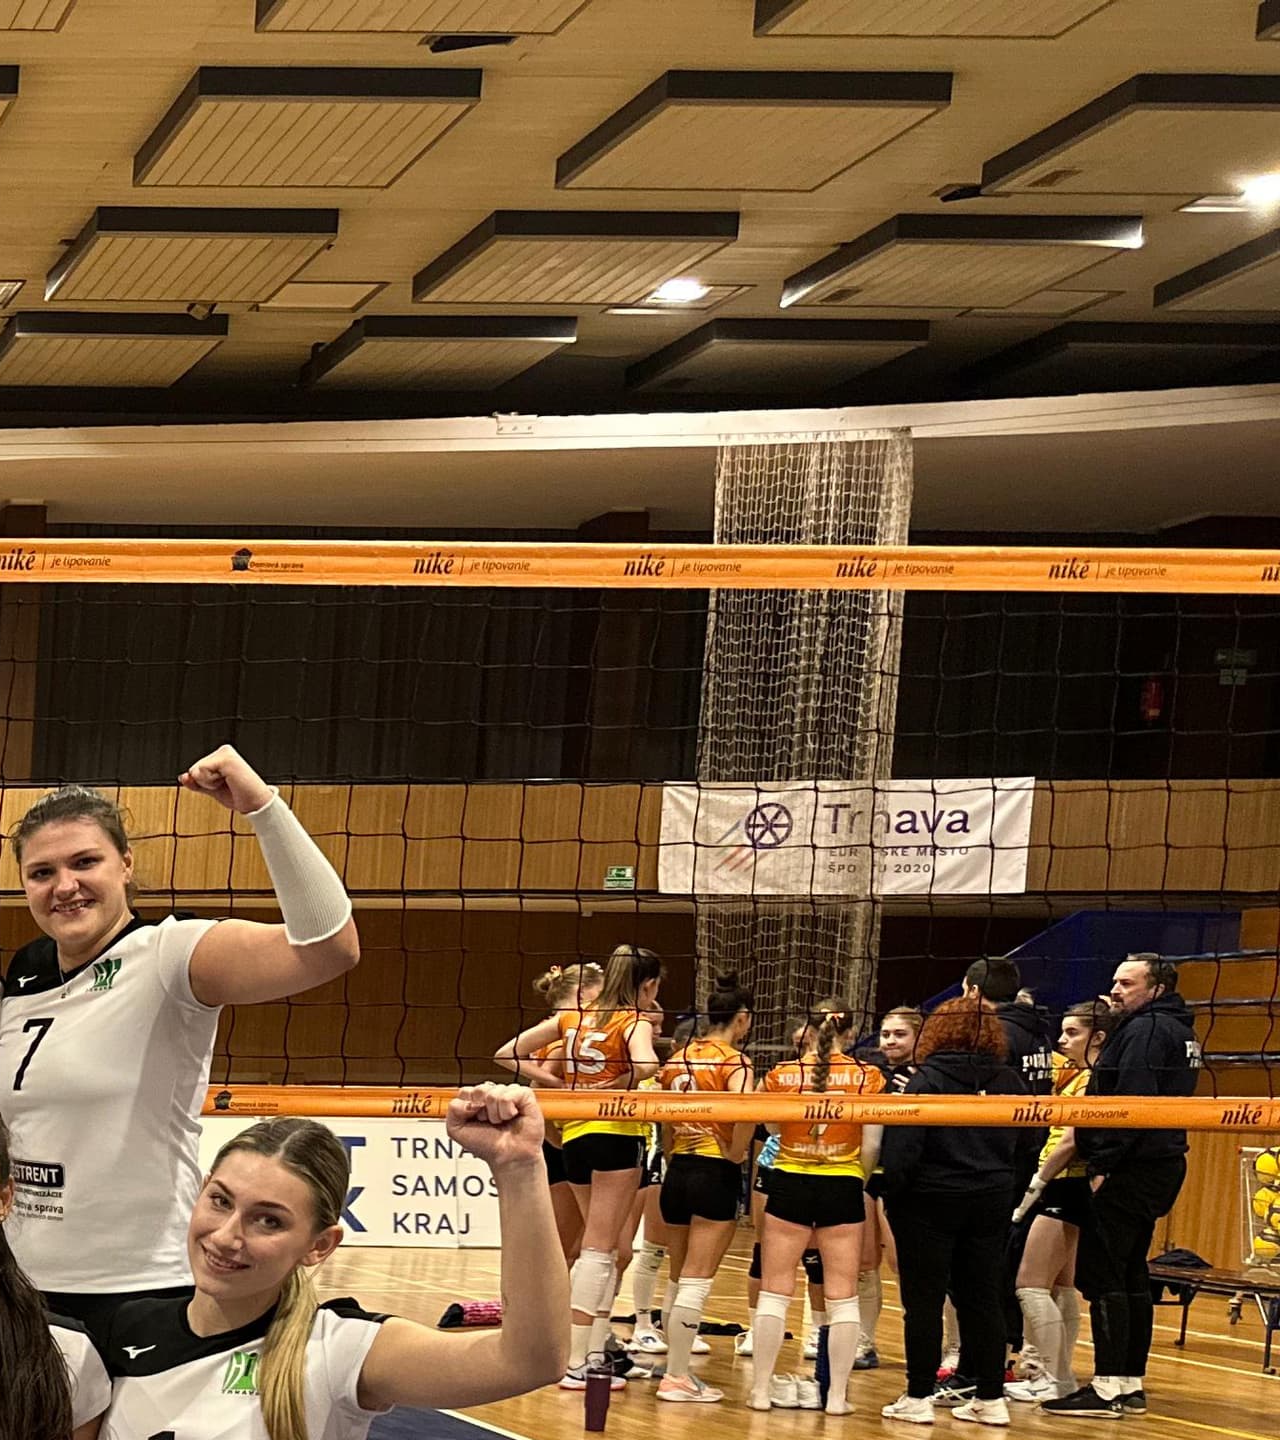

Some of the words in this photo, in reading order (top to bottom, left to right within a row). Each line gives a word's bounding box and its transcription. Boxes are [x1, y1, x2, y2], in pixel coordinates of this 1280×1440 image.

[63, 556, 111, 568] tipovanie
[413, 552, 454, 575] niké
[482, 559, 530, 572] tipovanie
[624, 554, 665, 577] niké
[693, 561, 741, 573] tipovanie
[836, 555, 877, 578] niké
[904, 563, 954, 576] tipovanie
[1048, 556, 1089, 579] niké
[1118, 565, 1167, 577] tipovanie
[823, 803, 971, 835] Trnava
[894, 863, 931, 874] 2020
[12, 1018, 55, 1092] 7
[565, 1028, 608, 1075] 15
[392, 1093, 432, 1115] niké
[599, 1096, 638, 1117] niké
[804, 1099, 844, 1120] niké
[1012, 1101, 1053, 1123] niké
[1220, 1103, 1262, 1125] niké
[393, 1211, 471, 1235] KRAJ
